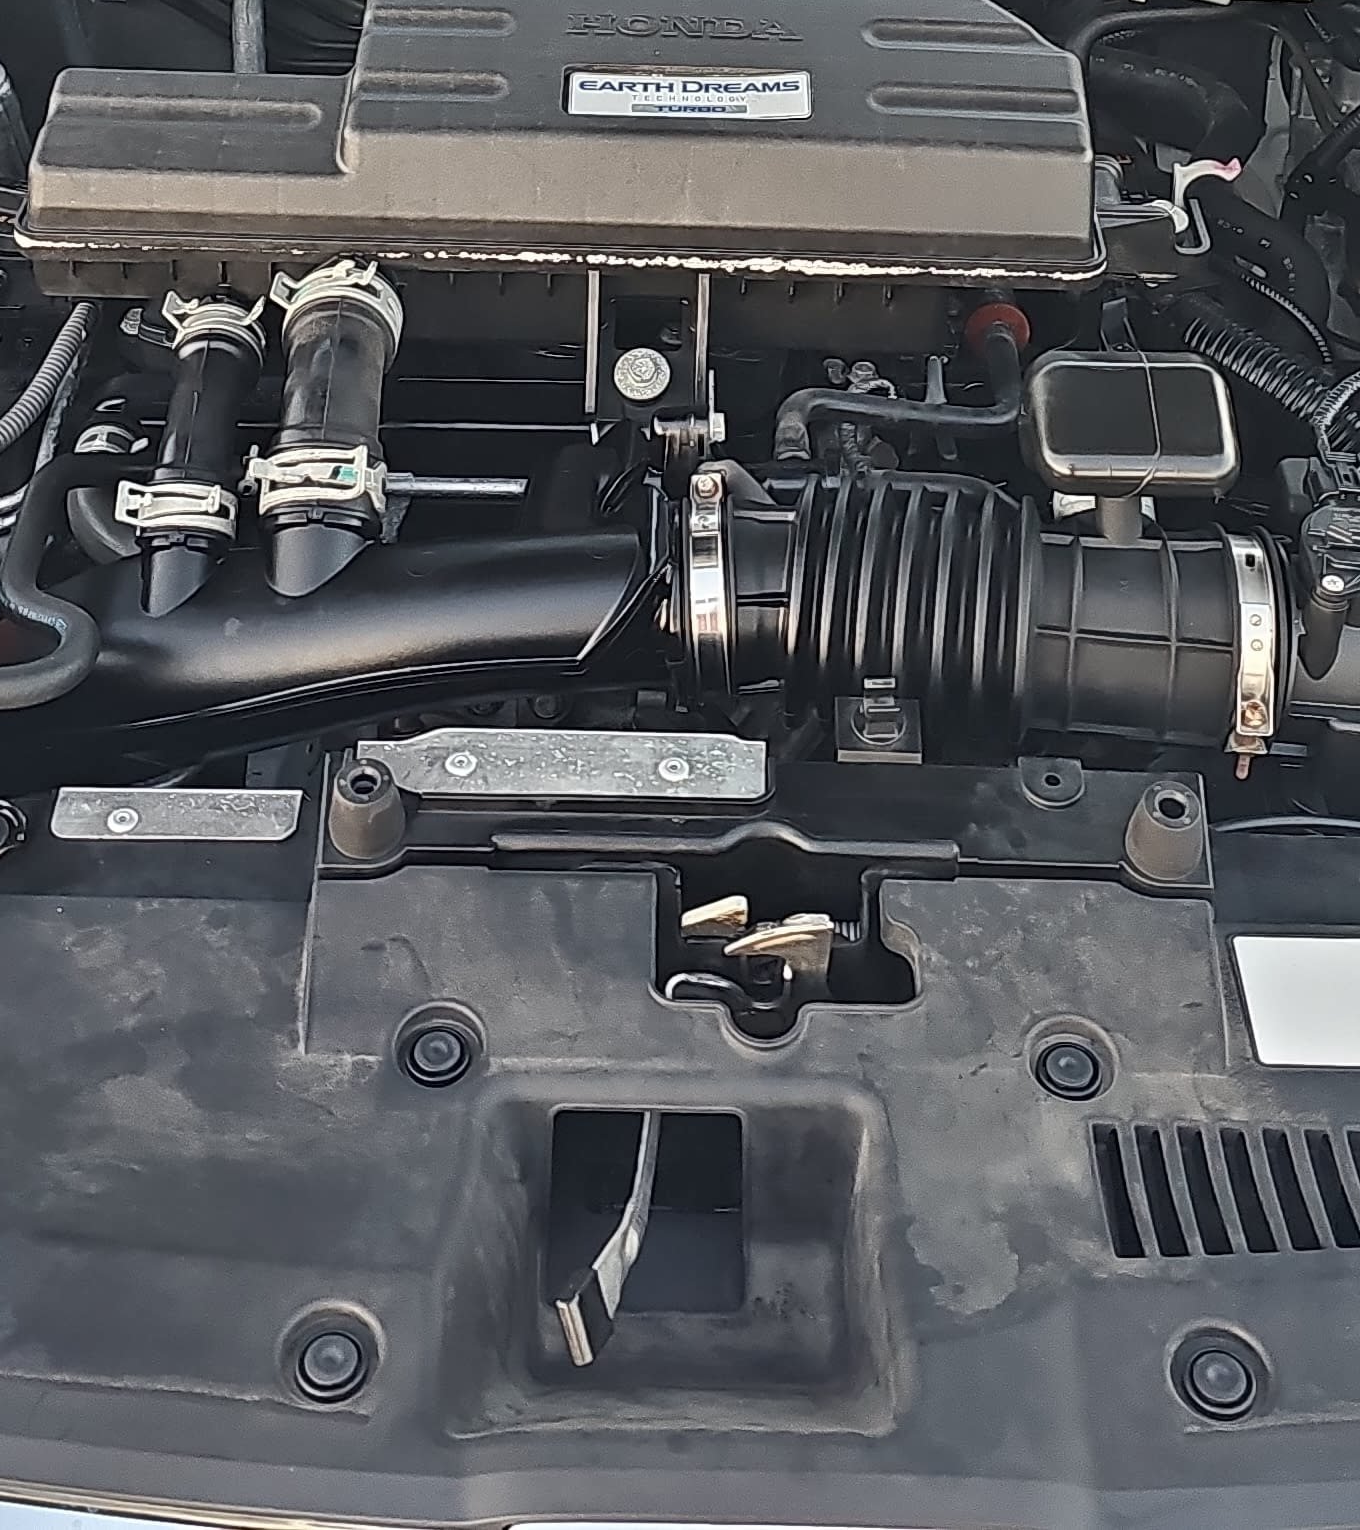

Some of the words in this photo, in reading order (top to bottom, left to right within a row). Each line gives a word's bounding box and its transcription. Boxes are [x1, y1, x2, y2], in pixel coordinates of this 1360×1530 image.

[565, 12, 804, 41] HONDA
[578, 80, 676, 94] EARTH
[681, 80, 801, 95] DREAMS
[632, 94, 747, 103] TECHNOLOGY
[655, 104, 728, 114] TURBO
